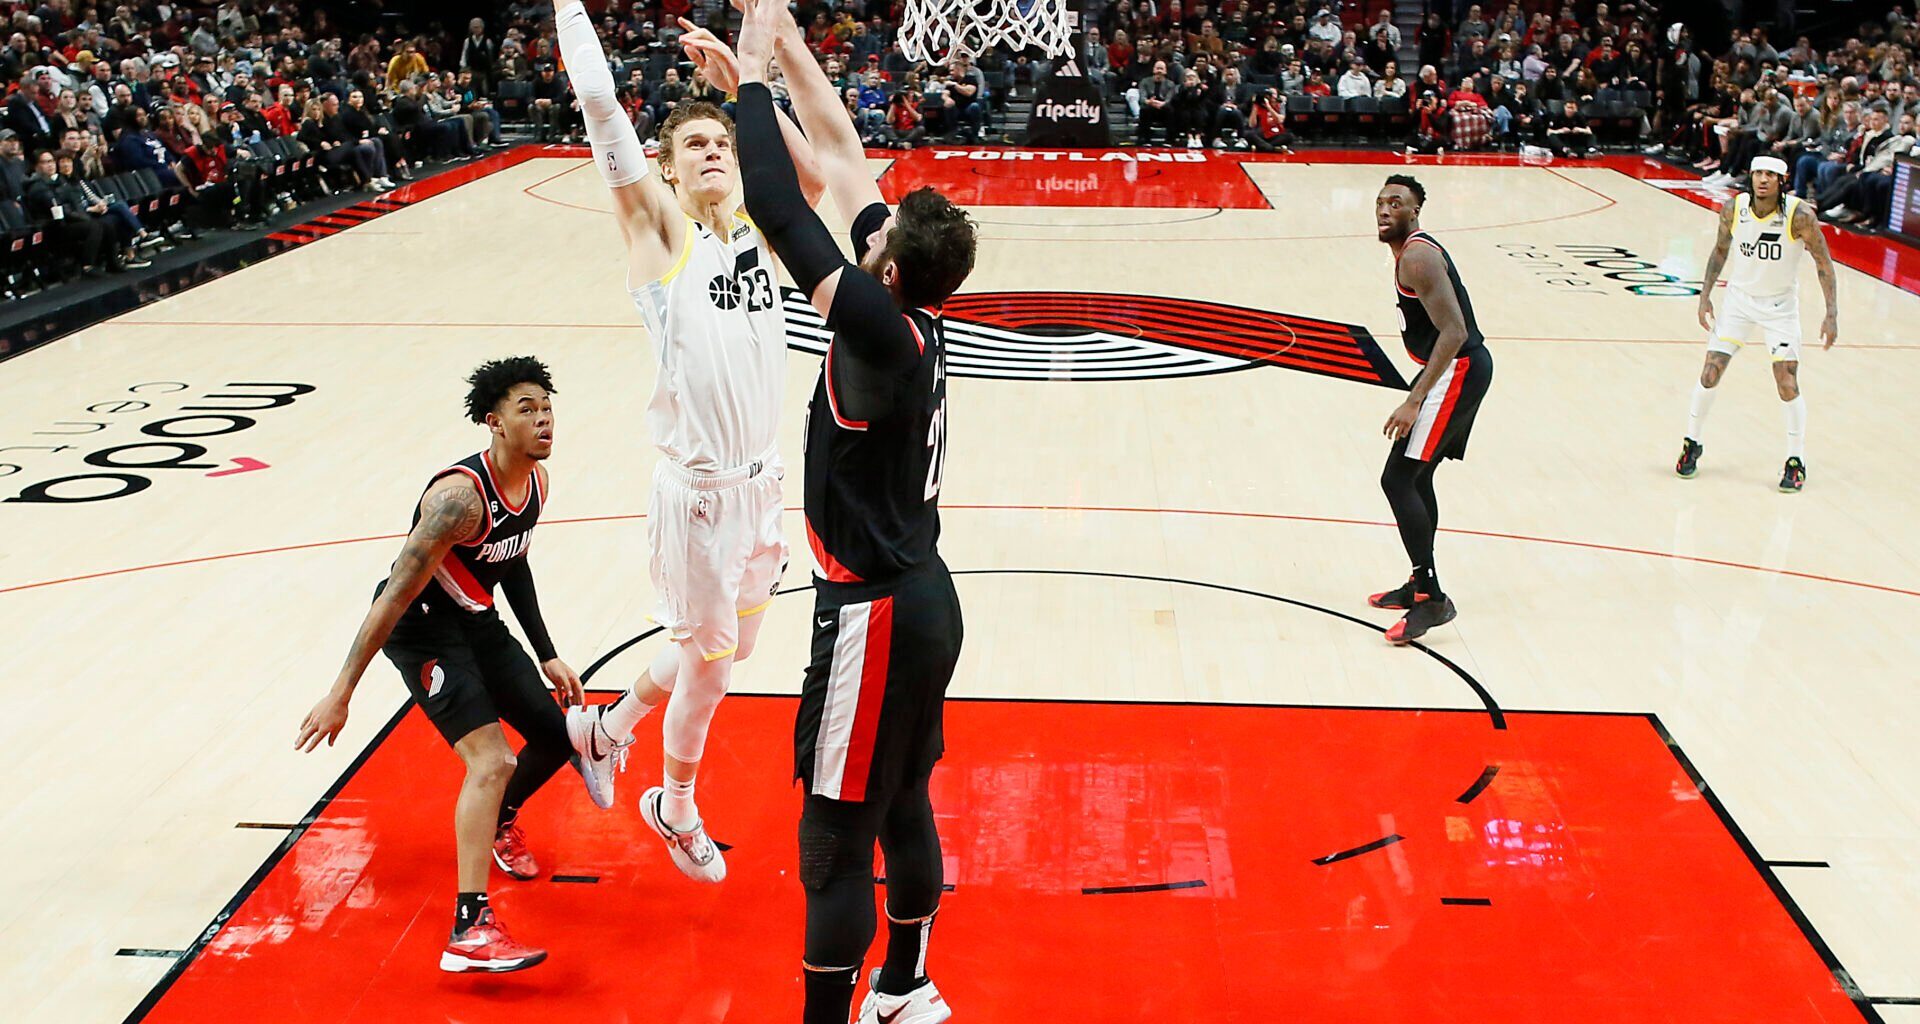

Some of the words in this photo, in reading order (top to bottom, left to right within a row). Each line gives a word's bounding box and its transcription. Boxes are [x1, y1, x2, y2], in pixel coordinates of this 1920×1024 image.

[1035, 99, 1100, 124] ripcity
[932, 150, 1207, 163] PORTLAND
[1758, 242, 1781, 260] 00
[741, 268, 773, 312] 23
[0, 381, 190, 477] cent
[2, 382, 317, 503] moda
[490, 500, 499, 513] 6
[475, 528, 534, 563] PORTLA
